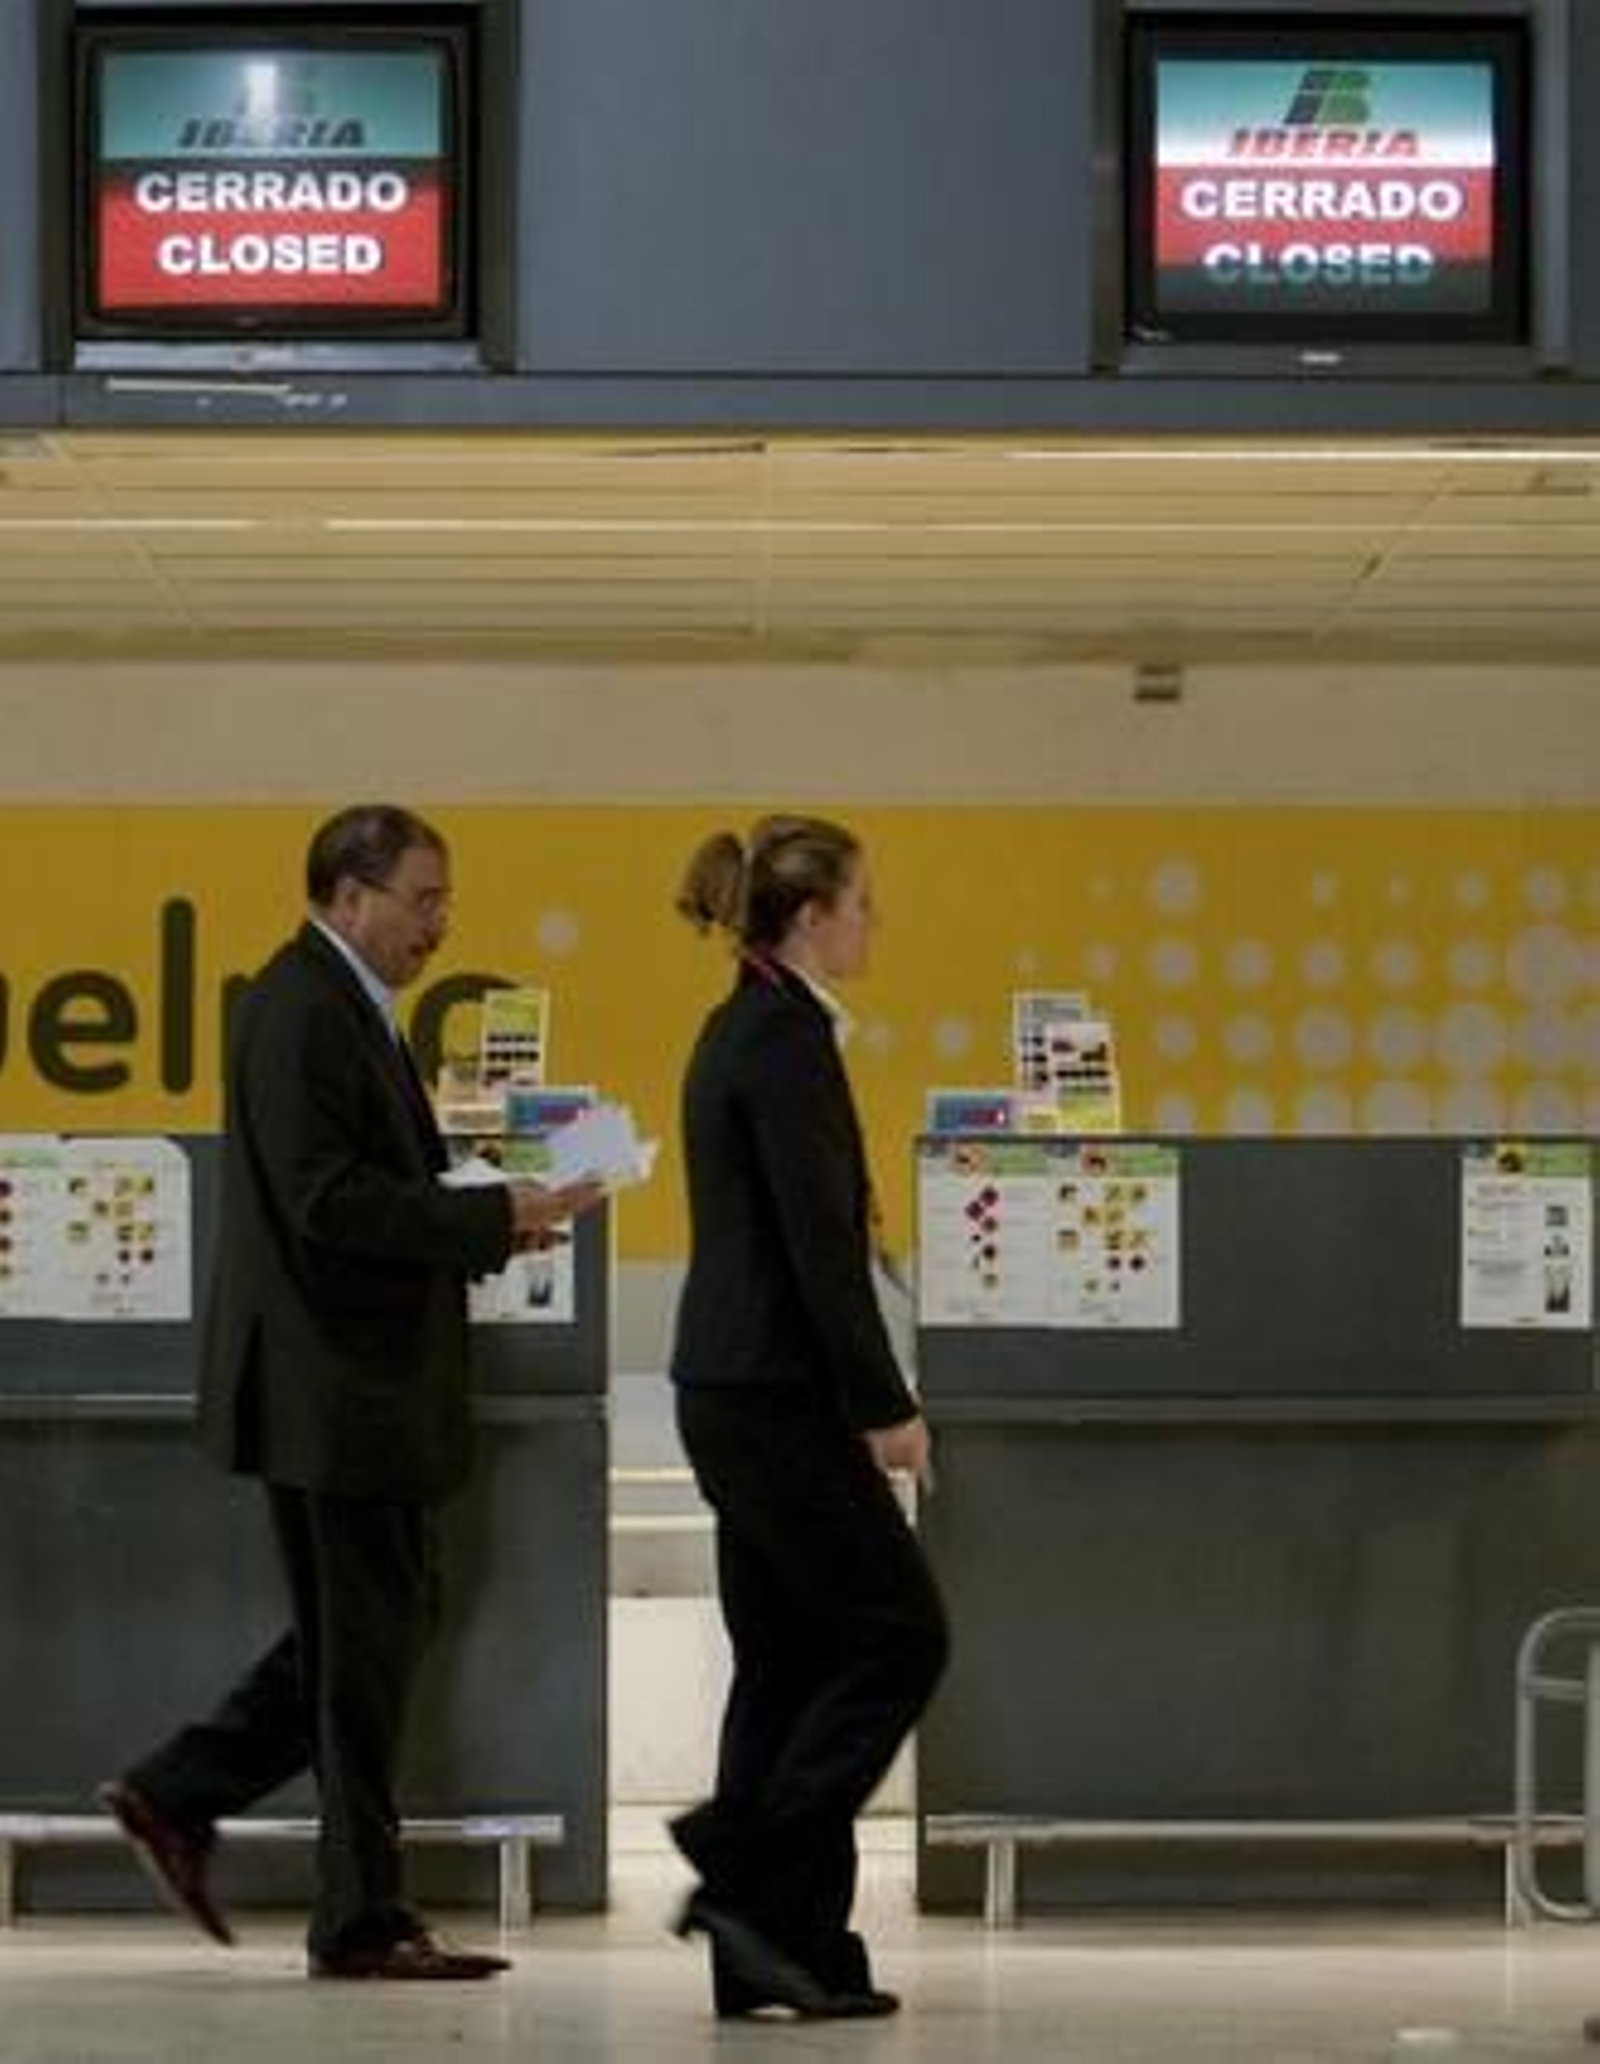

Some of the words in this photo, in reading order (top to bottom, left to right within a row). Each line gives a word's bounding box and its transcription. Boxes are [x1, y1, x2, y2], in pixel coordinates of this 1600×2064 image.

[1229, 129, 1420, 156] IBERIA
[136, 171, 408, 213] CERRADO
[1181, 182, 1464, 221] CERRADO
[156, 234, 383, 275] CLOSED
[1204, 244, 1434, 284] CLOSED
